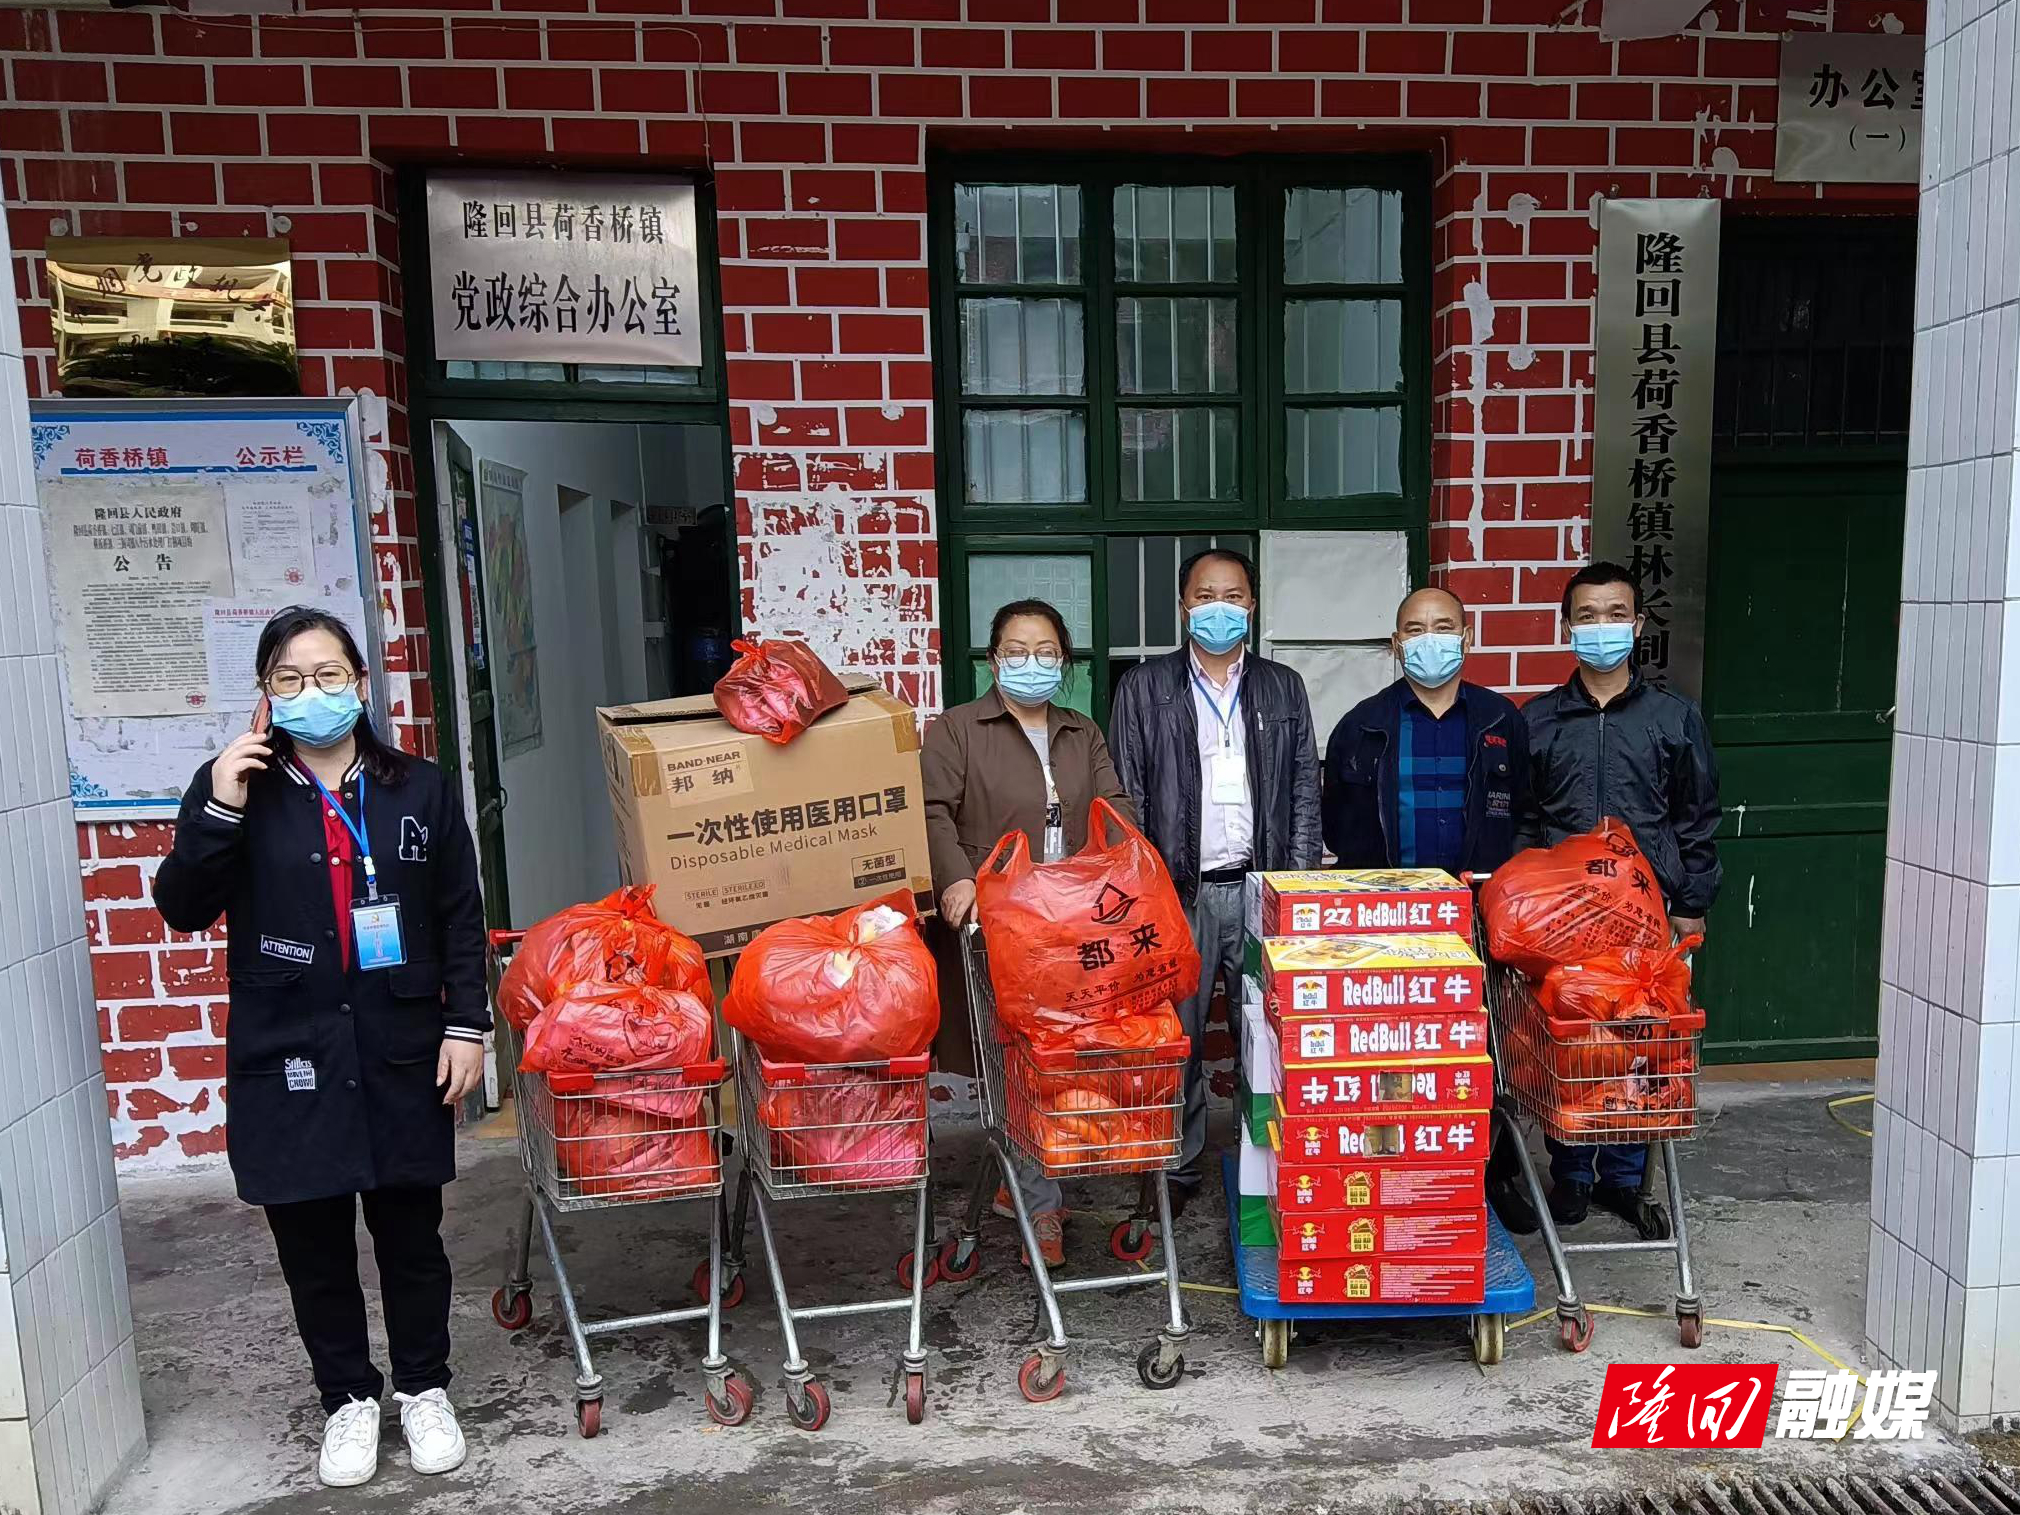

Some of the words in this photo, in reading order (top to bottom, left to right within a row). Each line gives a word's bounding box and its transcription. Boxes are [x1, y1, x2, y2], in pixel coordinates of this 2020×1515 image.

[462, 200, 664, 245] 隆回县荷香桥镇
[451, 270, 682, 336] 党政综合办公室
[74, 446, 169, 469] 荷香桥镇
[235, 446, 306, 466] 公示栏
[1625, 232, 1685, 692] 隆回县荷香桥镇林长制
[94, 506, 183, 520] 隆回县人民政府
[670, 767, 734, 795] 邦纳
[666, 786, 909, 848] 一次性使用医用口罩
[670, 844, 765, 872] Disposable
[770, 829, 833, 855] Medical
[837, 822, 878, 841] Mask
[862, 853, 897, 871] 无菌型
[686, 889, 717, 900] STERILE
[1357, 900, 1407, 928] RedBull
[1409, 900, 1460, 927] 红牛
[262, 939, 311, 960] ATTENTION
[1076, 922, 1162, 972] 都来
[1065, 980, 1121, 1003] 天天平价
[1342, 974, 1405, 1007] RedBull
[1408, 973, 1471, 1005] 红牛
[1349, 1021, 1411, 1054] RedBull
[1414, 1019, 1477, 1050] 红牛
[1300, 1074, 1362, 1106] 红牛
[1413, 1122, 1475, 1153] 红牛
